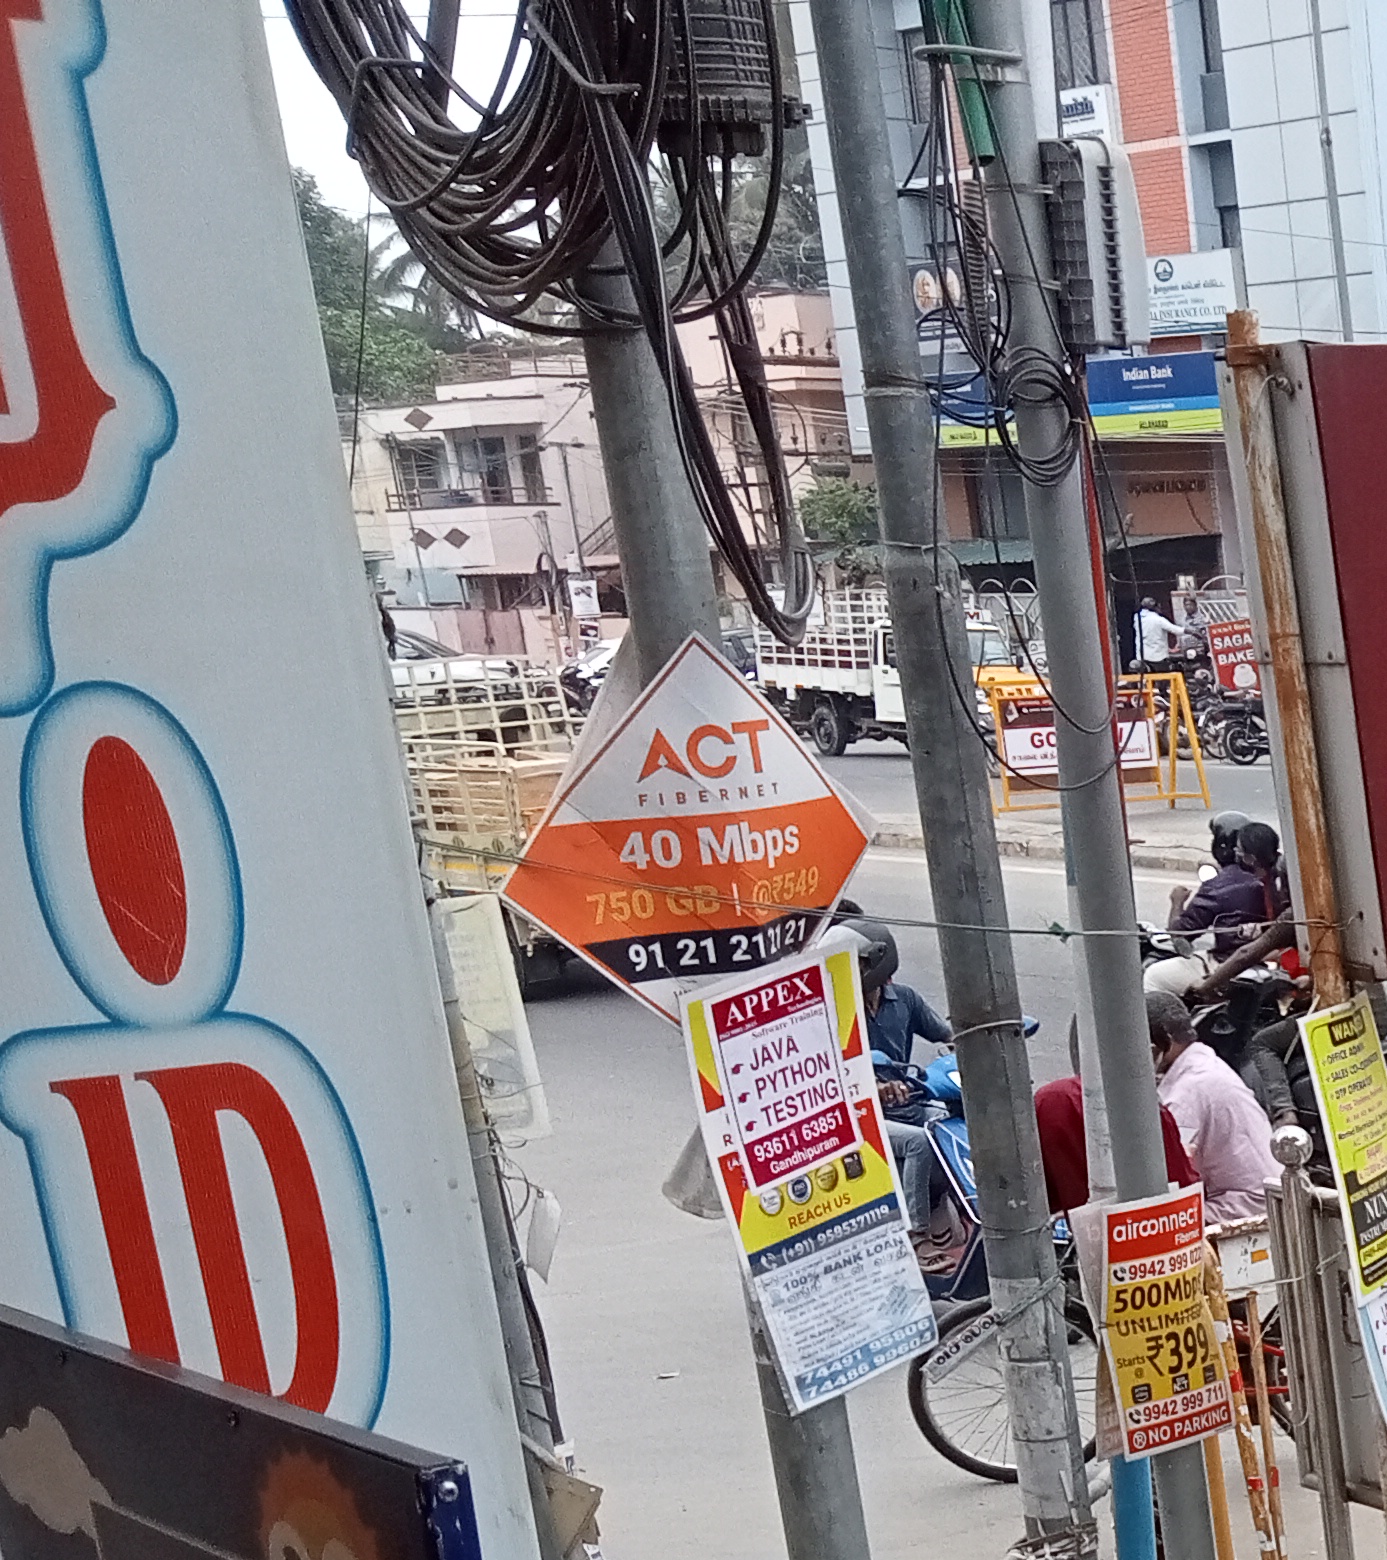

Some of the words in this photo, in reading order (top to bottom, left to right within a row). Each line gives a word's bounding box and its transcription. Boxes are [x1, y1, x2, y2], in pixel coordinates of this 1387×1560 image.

[1122, 367, 1149, 381] Indian
[1150, 365, 1173, 379] Bank
[637, 719, 770, 784] ACT
[638, 782, 779, 807] FIBERNET
[619, 829, 683, 870] 40
[697, 820, 800, 869] Mbps
[586, 887, 656, 926] 750
[666, 884, 721, 916] GB
[628, 940, 665, 972] 91
[676, 935, 717, 967] 21
[729, 933, 767, 963] 21
[725, 973, 814, 1028] APPEX
[752, 1019, 788, 1041] Software
[788, 1006, 824, 1027] Training
[750, 1035, 799, 1071] JAVA
[755, 1050, 830, 1100] PYTHON
[761, 1078, 839, 1128] TESTING
[753, 1128, 799, 1163] 93611
[801, 1107, 843, 1142] 63851
[769, 1135, 840, 1175] Gandhipuram
[788, 1202, 832, 1230] REACH
[834, 1192, 852, 1209] US
[1112, 1206, 1199, 1243] airconnect
[783, 1272, 821, 1293] 100%
[823, 1252, 864, 1275] BANK
[866, 1236, 905, 1258] LOAN
[1128, 1258, 1165, 1282] 9942
[1168, 1252, 1188, 1275] 999
[1116, 1355, 1146, 1369] Starts
[1143, 1399, 1180, 1423] 9942
[1182, 1392, 1204, 1414] 999
[1206, 1385, 1224, 1406] 711
[1150, 1422, 1171, 1444] NO
[1173, 1403, 1229, 1439] PARKING
